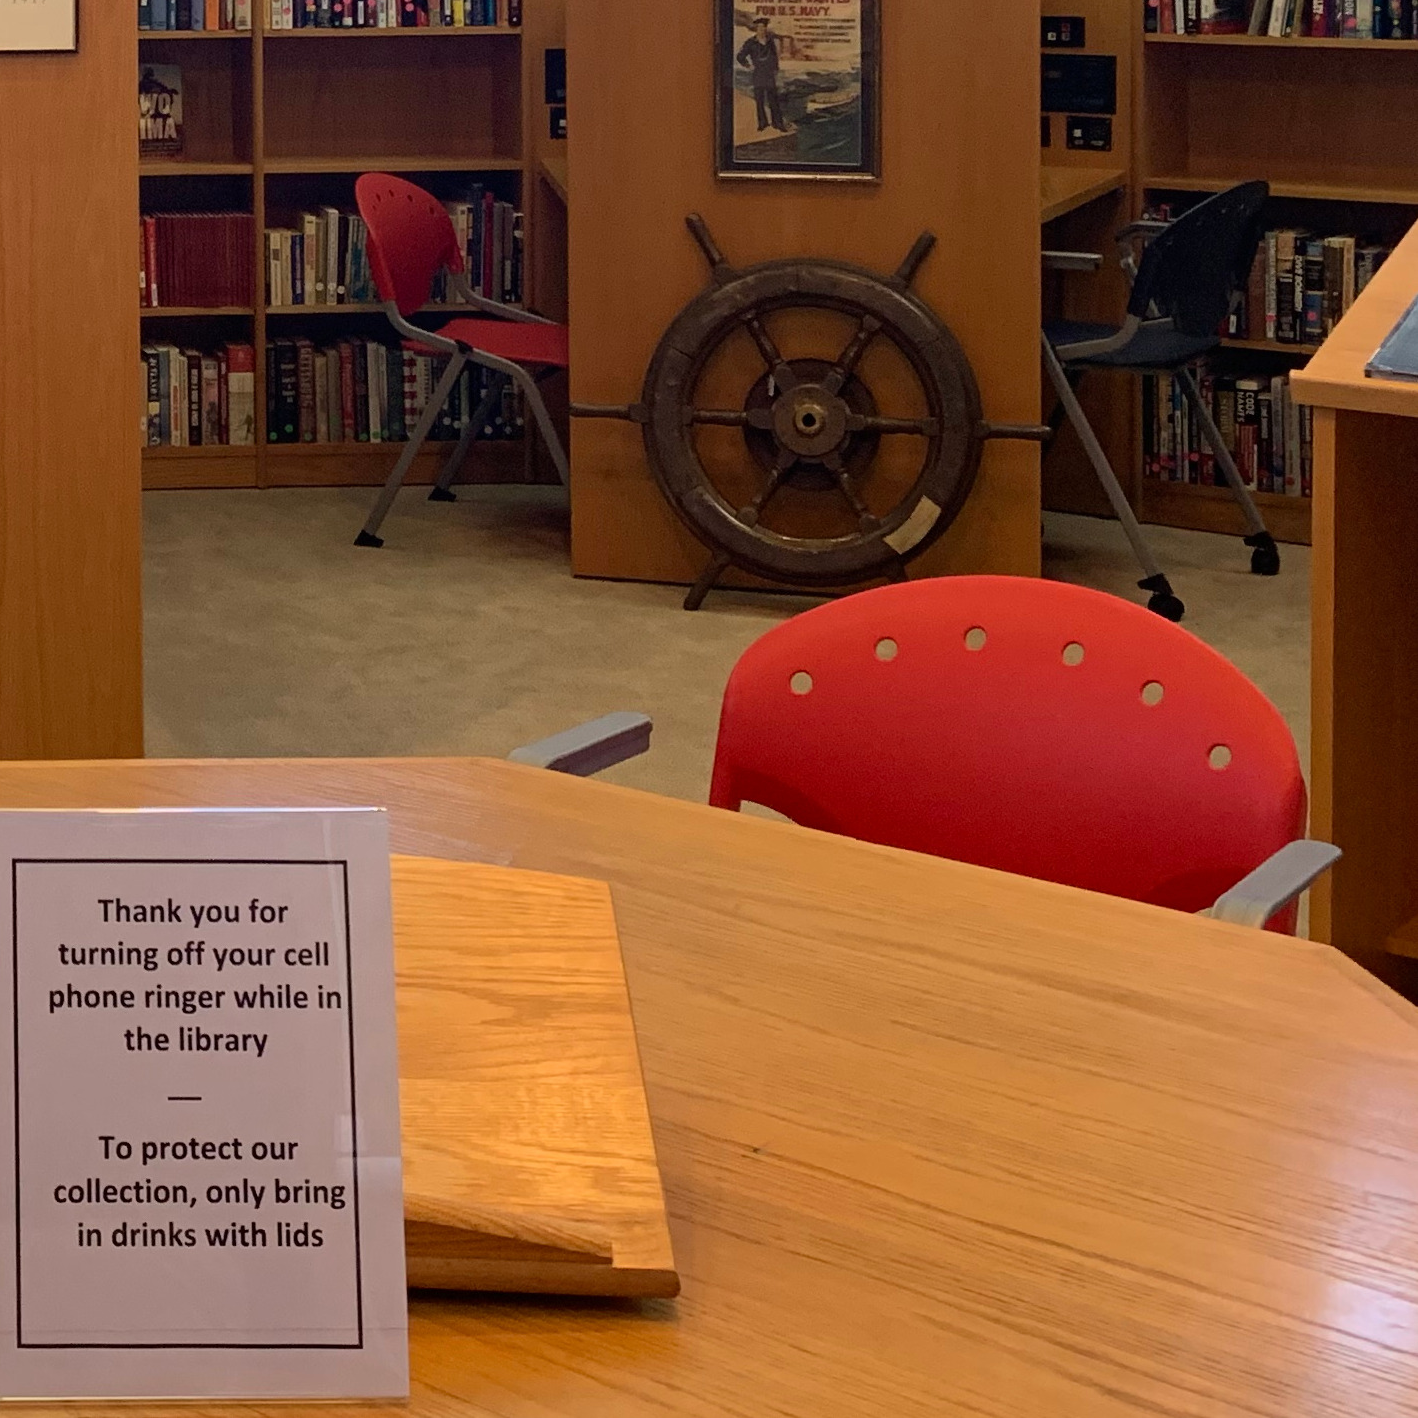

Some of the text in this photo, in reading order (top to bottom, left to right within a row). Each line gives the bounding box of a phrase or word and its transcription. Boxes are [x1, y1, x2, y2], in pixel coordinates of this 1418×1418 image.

[756, 6, 775, 16] FOR
[1236, 392, 1245, 422] NAMES
[1246, 392, 1255, 416] CODE
[97, 897, 289, 929] Thank you for
[57, 940, 329, 972] turning off your cell
[49, 983, 342, 1015] phone ringer while in
[123, 1025, 268, 1058] the library
[98, 1135, 299, 1166] To protect our
[53, 1177, 346, 1210] collection, only bring
[77, 1221, 324, 1248] in drinks with lids
